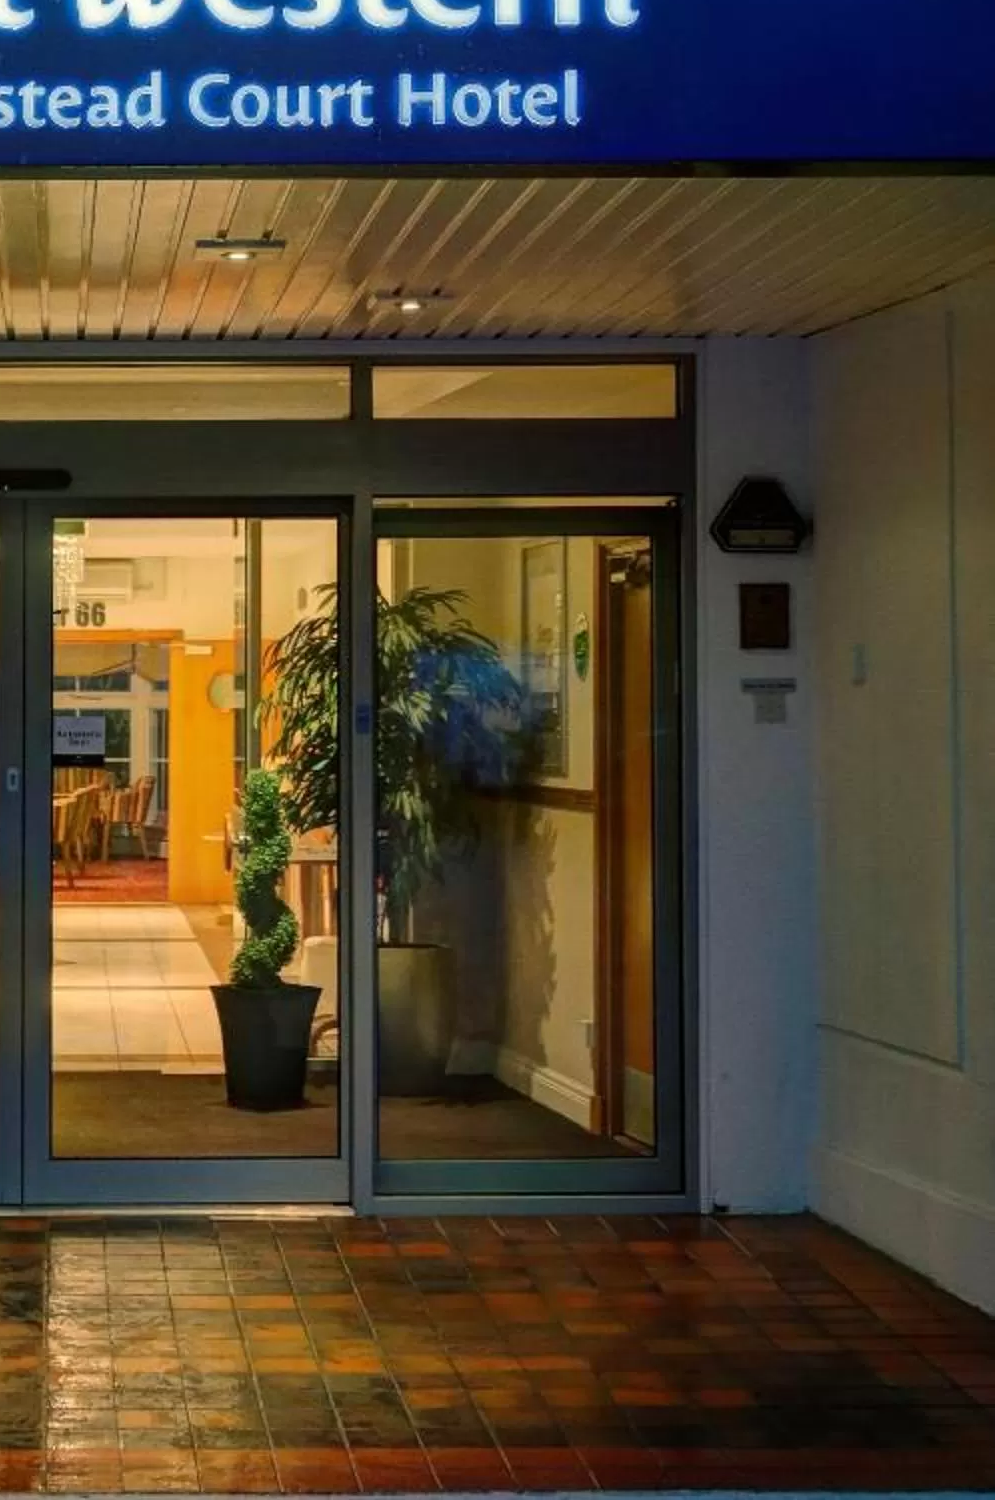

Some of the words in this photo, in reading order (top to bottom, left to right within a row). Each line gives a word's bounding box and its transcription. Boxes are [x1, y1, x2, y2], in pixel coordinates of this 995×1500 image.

[188, 73, 374, 127] Court
[398, 69, 580, 127] Hotel
[75, 602, 106, 628] 66
